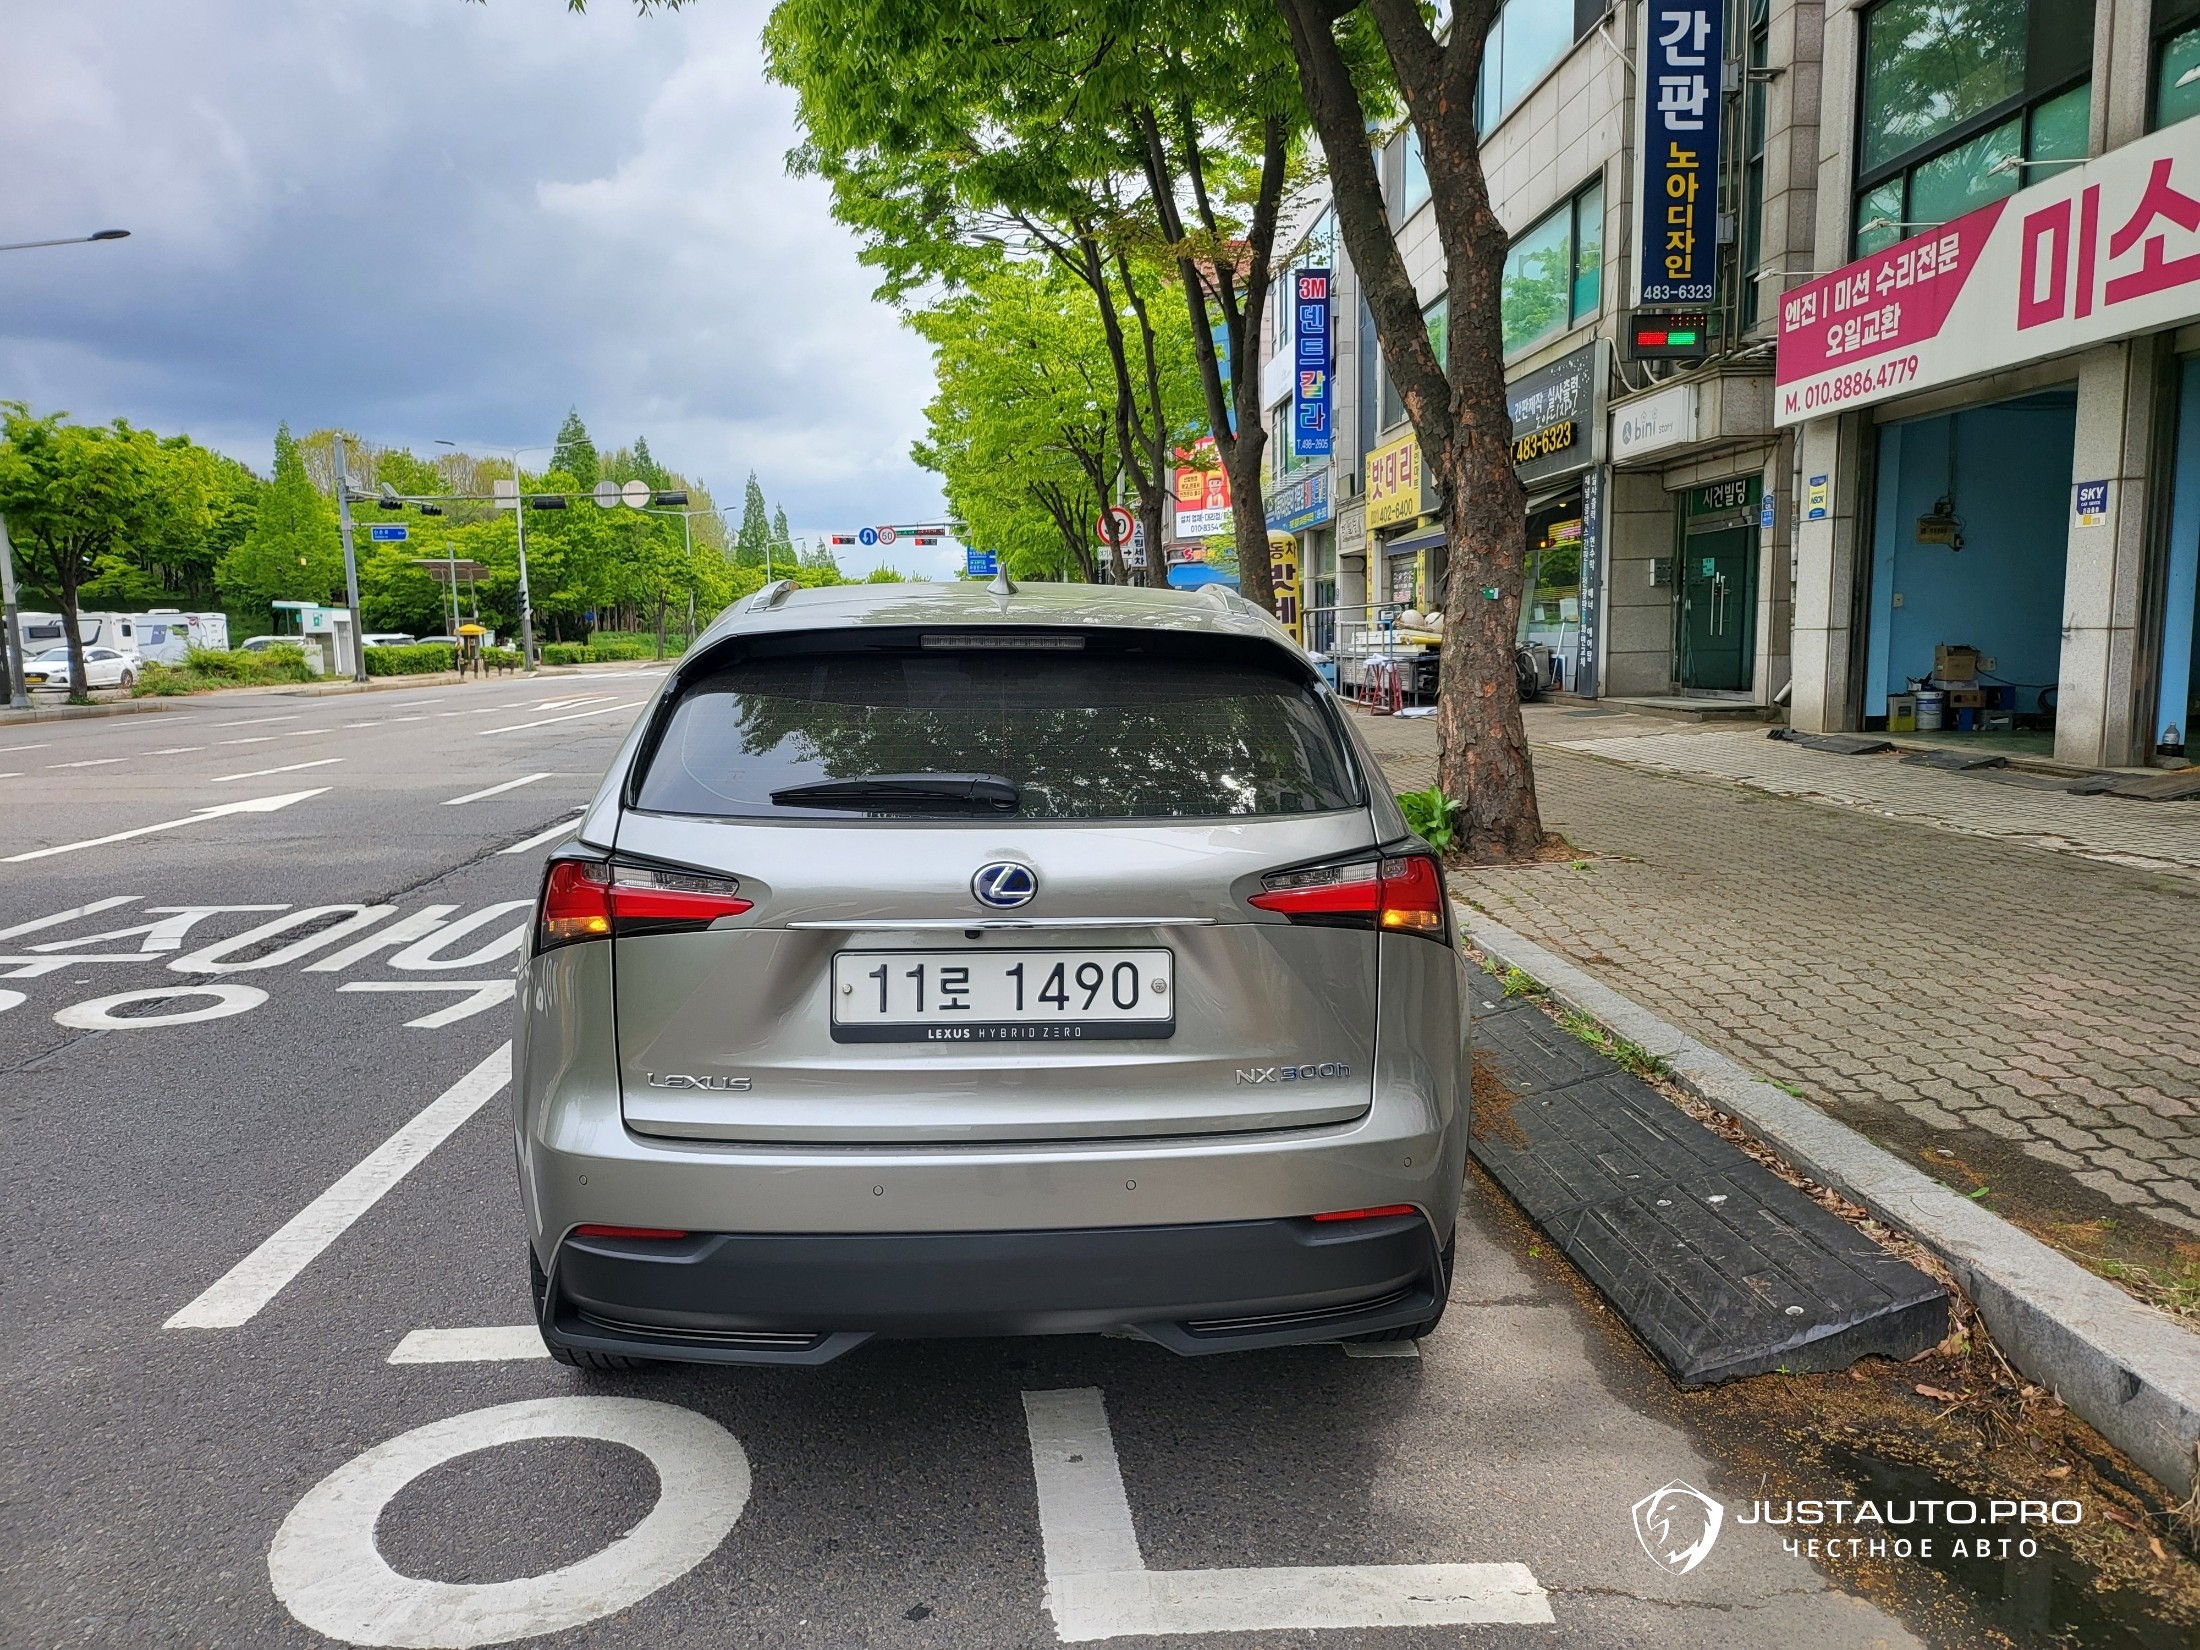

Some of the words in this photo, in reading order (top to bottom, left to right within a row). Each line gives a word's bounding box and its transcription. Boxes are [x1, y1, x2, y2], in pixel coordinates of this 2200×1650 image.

[1658, 11, 1711, 130] 간판
[1665, 141, 1700, 279] 노아디자인
[2017, 157, 2200, 331] 미소
[1299, 278, 1326, 299] 3M
[1644, 285, 1712, 299] 483-6323
[1785, 292, 1817, 333] 엔진
[1834, 269, 1870, 313] 미션
[1875, 232, 1960, 297] 수리전문
[1825, 302, 1901, 358] 오일교환
[1785, 391, 1801, 415] M.
[1805, 354, 1919, 410] 010.8886.4779
[1634, 417, 1656, 441] bini
[1658, 421, 1673, 434] story
[1372, 443, 1413, 501] 밧데리
[1703, 480, 1746, 508] 시건빌딩
[2080, 486, 2104, 501] SKY
[882, 531, 892, 541] 50
[1190, 523, 1222, 533] 010-8354-
[1134, 530, 1144, 565] 스팀세차
[1269, 541, 1296, 560] 동차
[1271, 564, 1297, 639] 밧데
[869, 963, 971, 1013] 11로
[1005, 961, 1139, 1011] 1490
[928, 1029, 971, 1039] LEXUS
[979, 1027, 1035, 1039] HYBRID
[1043, 1027, 1082, 1038] ZERO
[647, 1073, 752, 1091] LEXUS
[1235, 1067, 1277, 1085] NX
[1280, 1062, 1351, 1080] 300h
